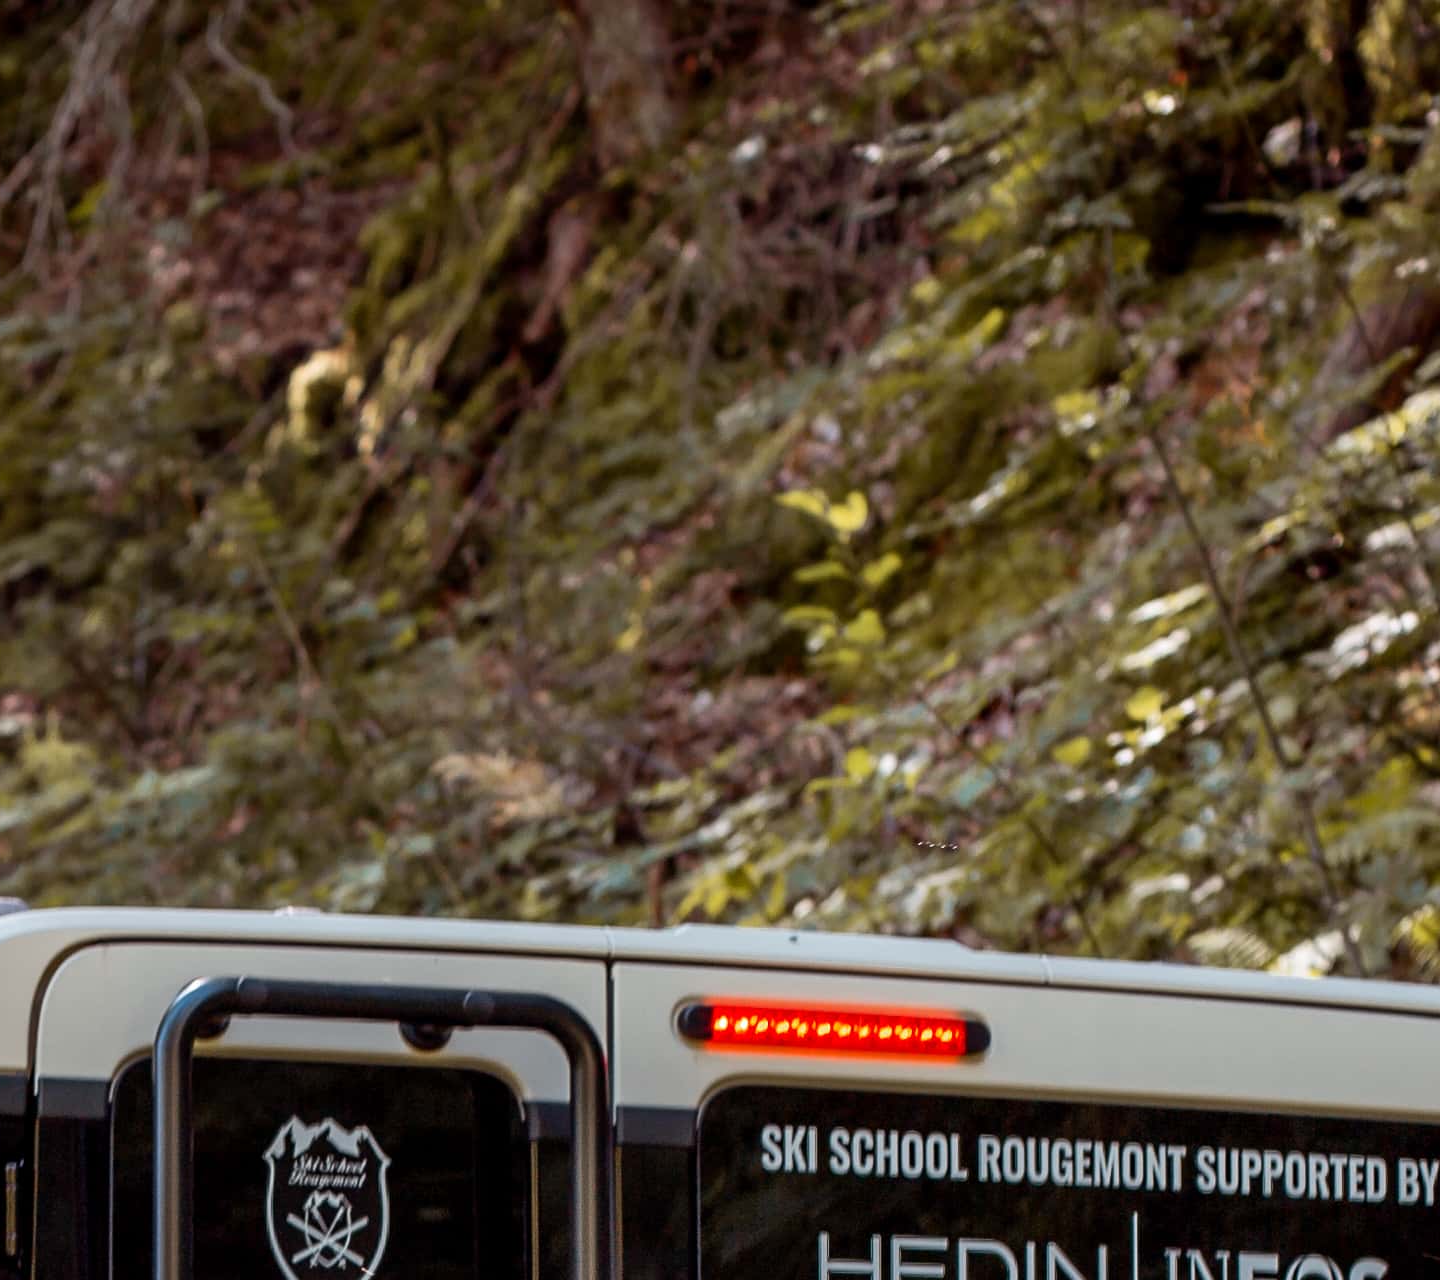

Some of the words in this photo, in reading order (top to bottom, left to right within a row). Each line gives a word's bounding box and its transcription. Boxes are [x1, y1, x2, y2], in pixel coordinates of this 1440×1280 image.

[760, 1124, 818, 1175] SKI
[828, 1127, 969, 1183] SCHOOL
[977, 1135, 1187, 1193] ROUGEMONT
[1195, 1145, 1387, 1203] SUPPORTED
[1396, 1157, 1440, 1207] BY
